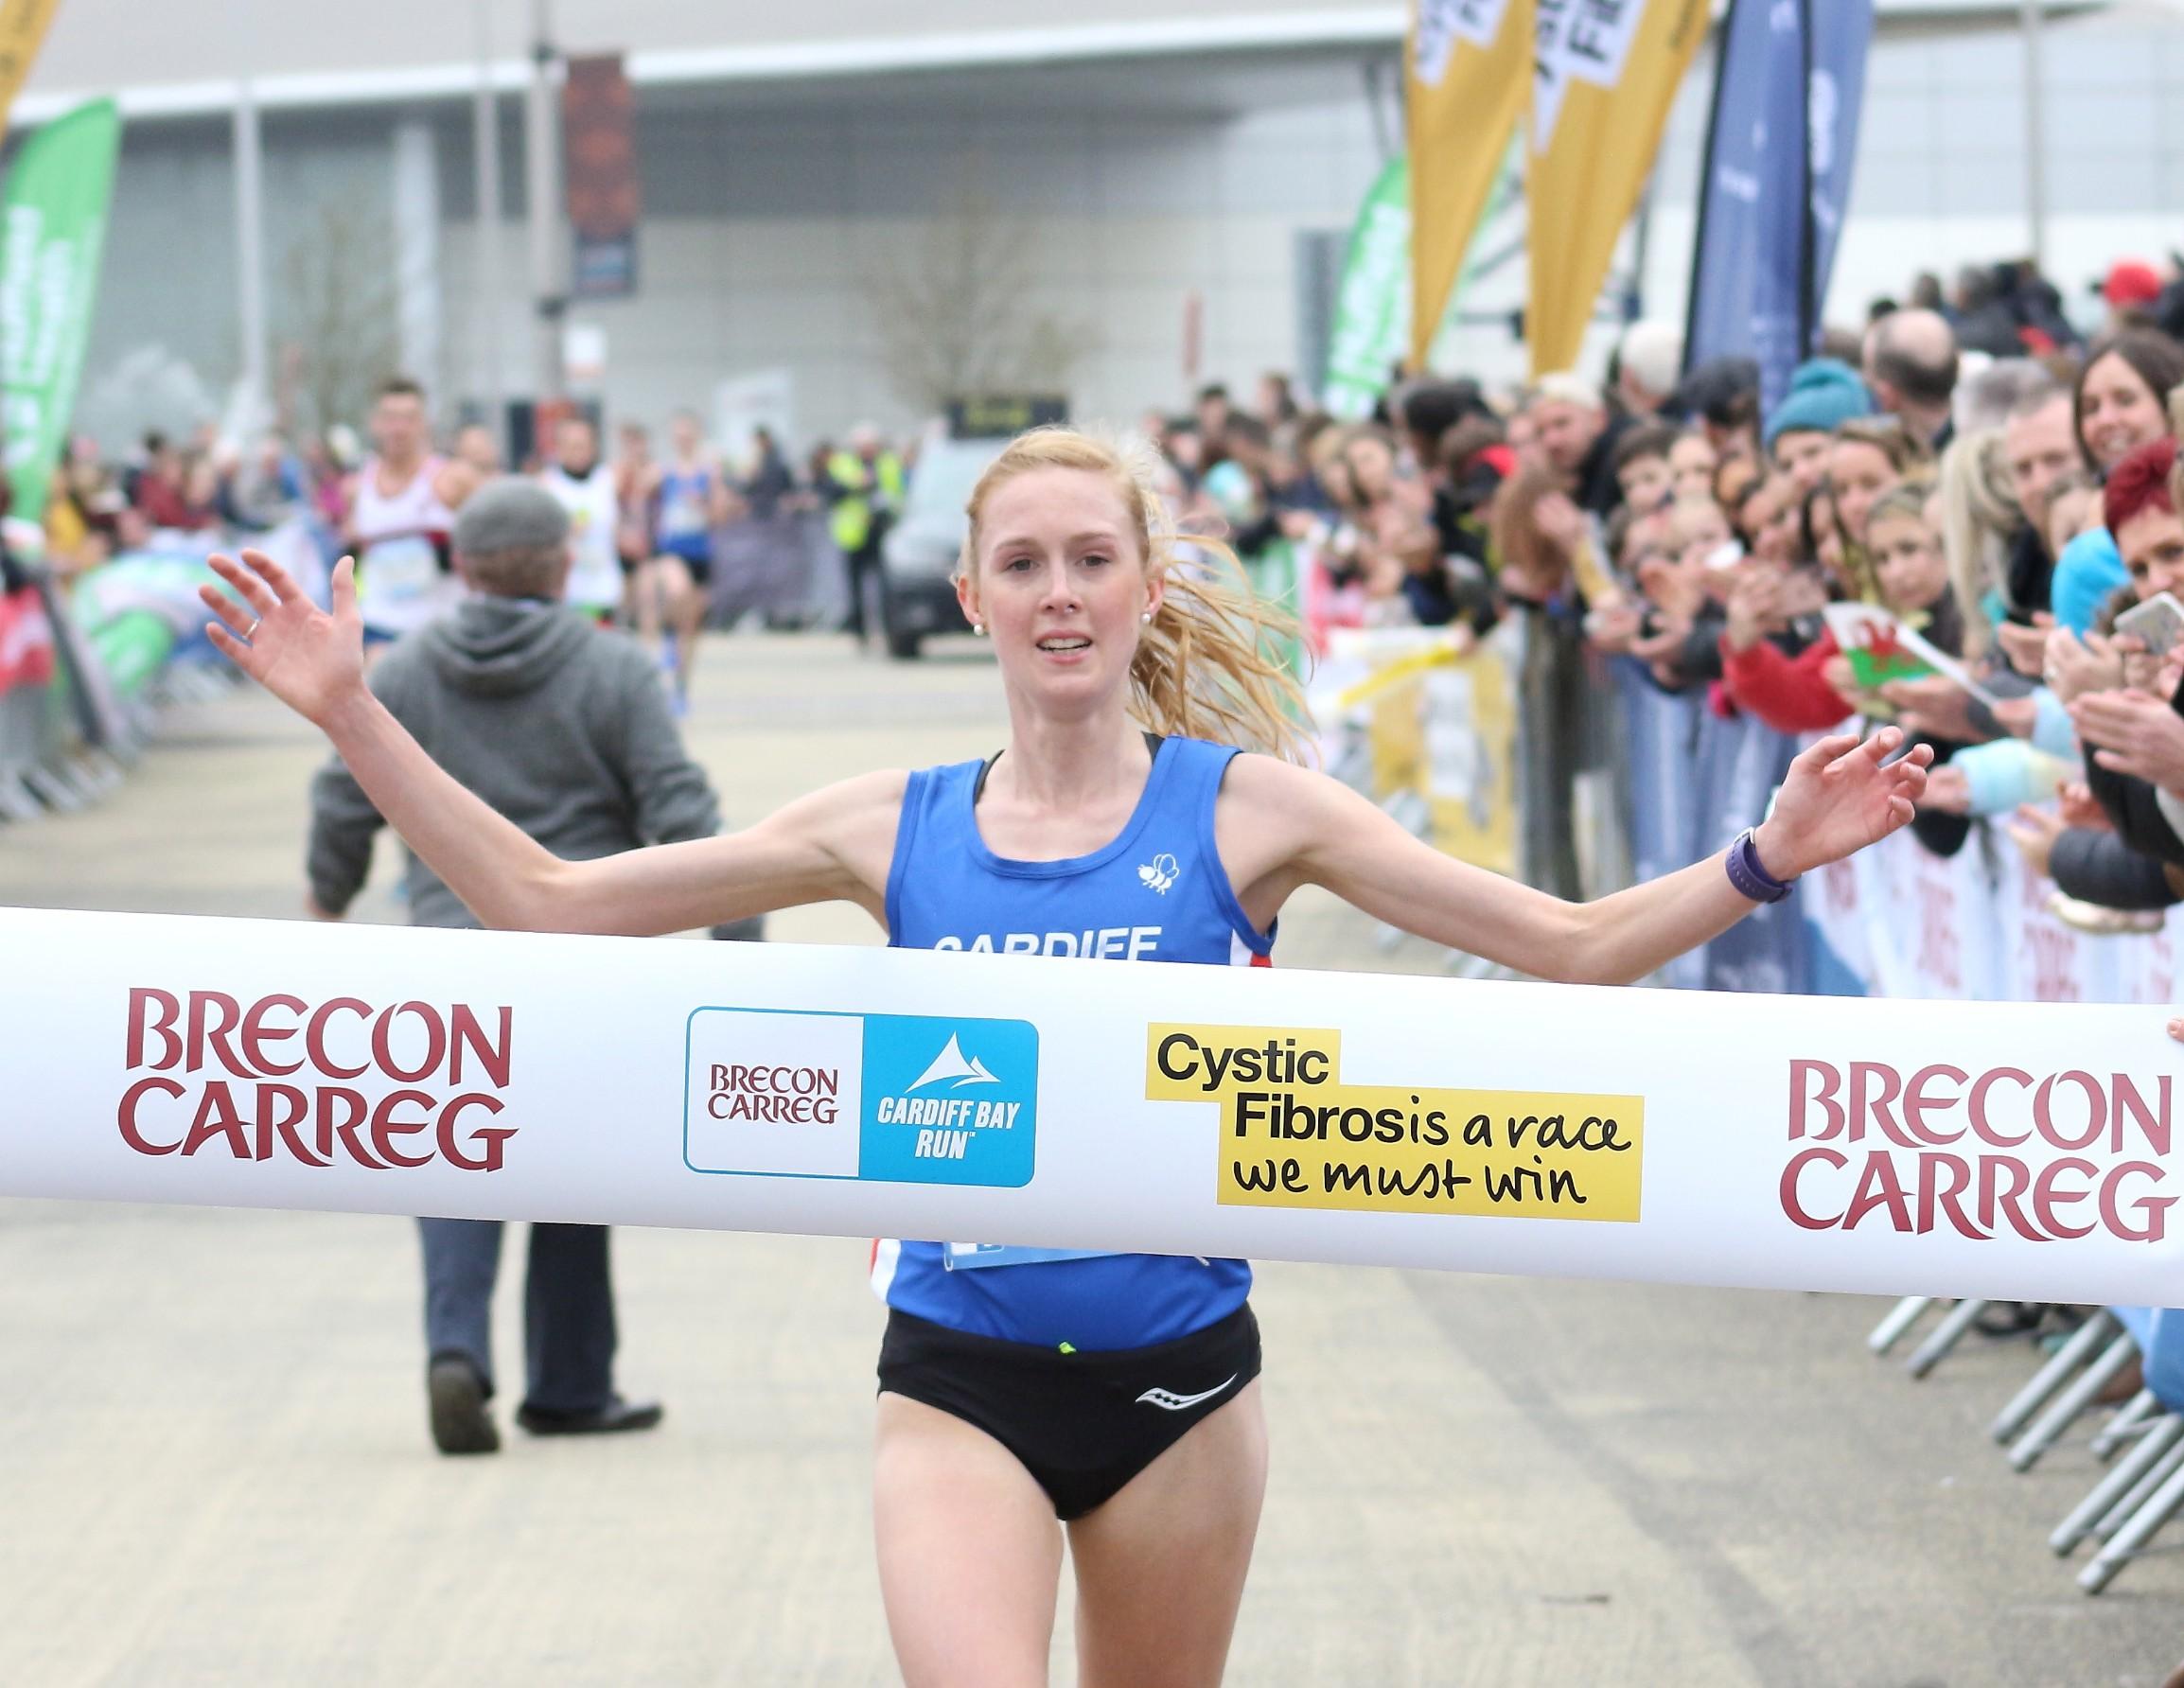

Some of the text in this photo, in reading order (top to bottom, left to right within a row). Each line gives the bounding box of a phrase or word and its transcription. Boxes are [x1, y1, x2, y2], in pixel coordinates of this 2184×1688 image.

[126, 987, 513, 1089] BRECON
[1157, 1033, 1330, 1092] Cystic
[710, 1064, 839, 1096] BRECON
[117, 1077, 520, 1172] CARREG
[708, 1093, 840, 1124] CARREG
[877, 1097, 1021, 1129] CARDIFF BAY
[1463, 1115, 1492, 1148] a
[1507, 1114, 1632, 1152] race
[1788, 1059, 2173, 1157] BRECON
[1234, 1154, 1587, 1204] we must win
[1779, 1147, 2181, 1243] CARREG
